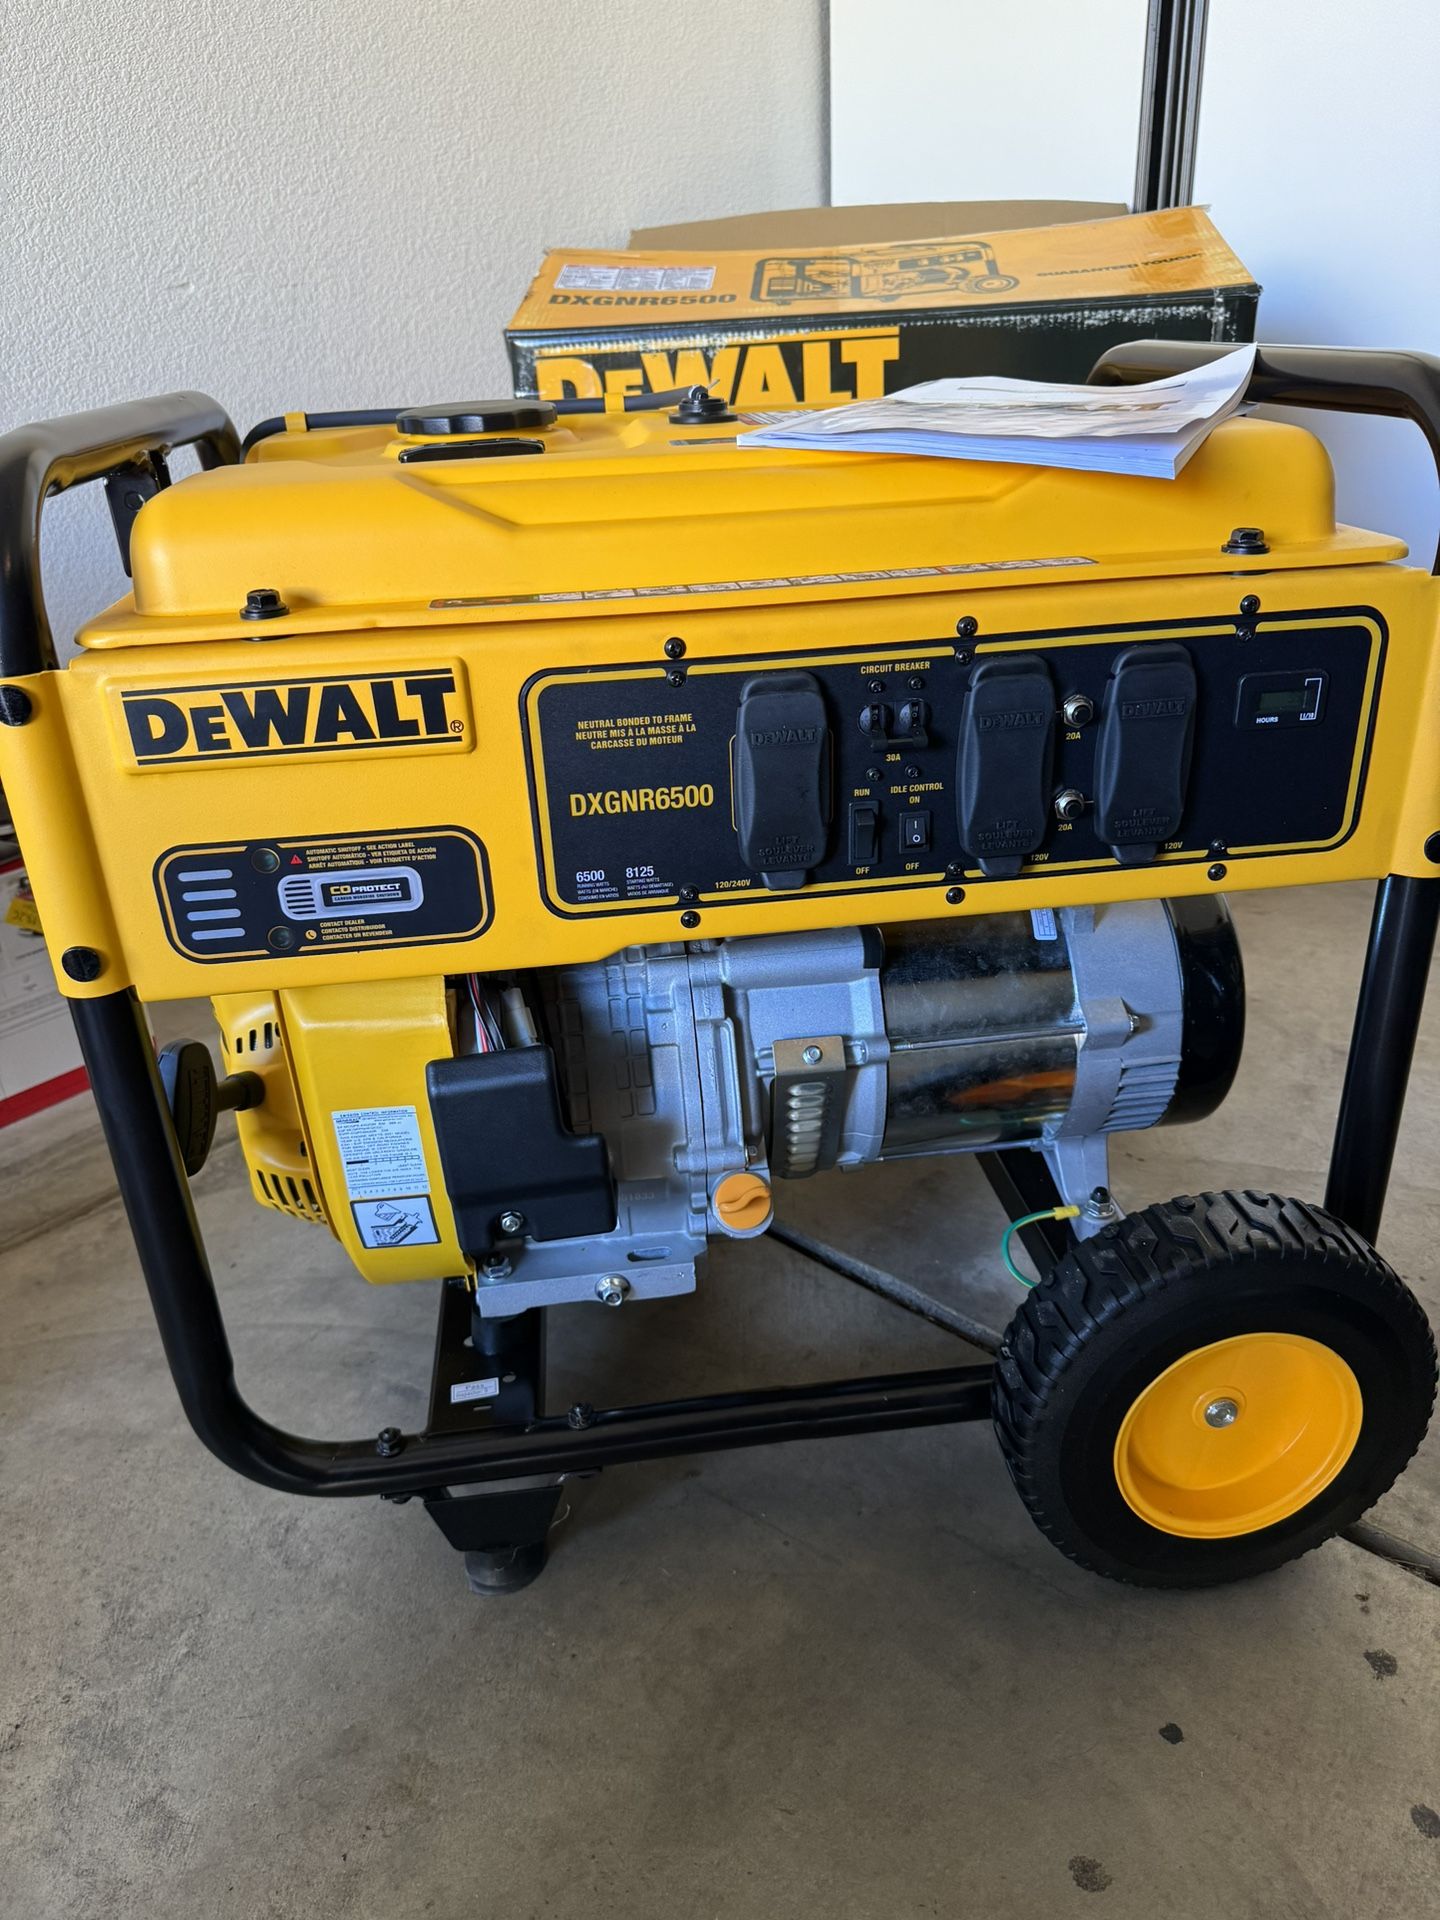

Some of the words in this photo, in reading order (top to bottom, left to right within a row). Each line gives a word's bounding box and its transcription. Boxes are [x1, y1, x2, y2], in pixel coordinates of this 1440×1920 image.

[548, 294, 737, 306] DXGNR6500
[536, 337, 901, 405] DEWALT
[860, 664, 893, 674] CIRCUIT
[894, 661, 931, 672] BREAKER
[123, 676, 457, 758] DEWALT
[578, 719, 616, 730] NEUTRAL
[616, 716, 651, 727] BONDED
[652, 715, 663, 724] TO
[664, 713, 693, 724] FRAME
[1256, 716, 1279, 724] HOURS
[576, 730, 608, 740] NEUTRE
[610, 728, 626, 738] MIS
[628, 727, 634, 737] À
[636, 726, 646, 736] LA
[647, 724, 676, 735] MASSE
[678, 723, 684, 733] À
[686, 724, 696, 732] LA
[751, 728, 816, 746] DEWALT
[1066, 732, 1082, 740] 20A
[590, 738, 634, 750] CARCASSE
[636, 738, 648, 746] DU
[649, 735, 683, 746] MOTEUR
[886, 753, 902, 762] 30A
[854, 788, 870, 797] RUN
[890, 785, 908, 794] IDLE
[909, 782, 944, 792] CONTROL
[570, 784, 714, 817] DXGNR6500
[909, 796, 920, 804] ON
[1058, 823, 1073, 832] 20A
[306, 847, 337, 856] AUTOMATIC
[338, 845, 362, 853] SHUTOFF
[1164, 840, 1183, 850] 120V
[1031, 852, 1050, 862] 120V
[626, 866, 654, 878] 8125
[855, 866, 870, 875] OFF
[905, 862, 920, 870] OFF
[576, 870, 605, 882] 6500
[330, 885, 352, 895] CO
[352, 883, 401, 893] PROTECT
[714, 878, 751, 890] 120/240V
[348, 924, 386, 932] DISTRIBUIDOR
